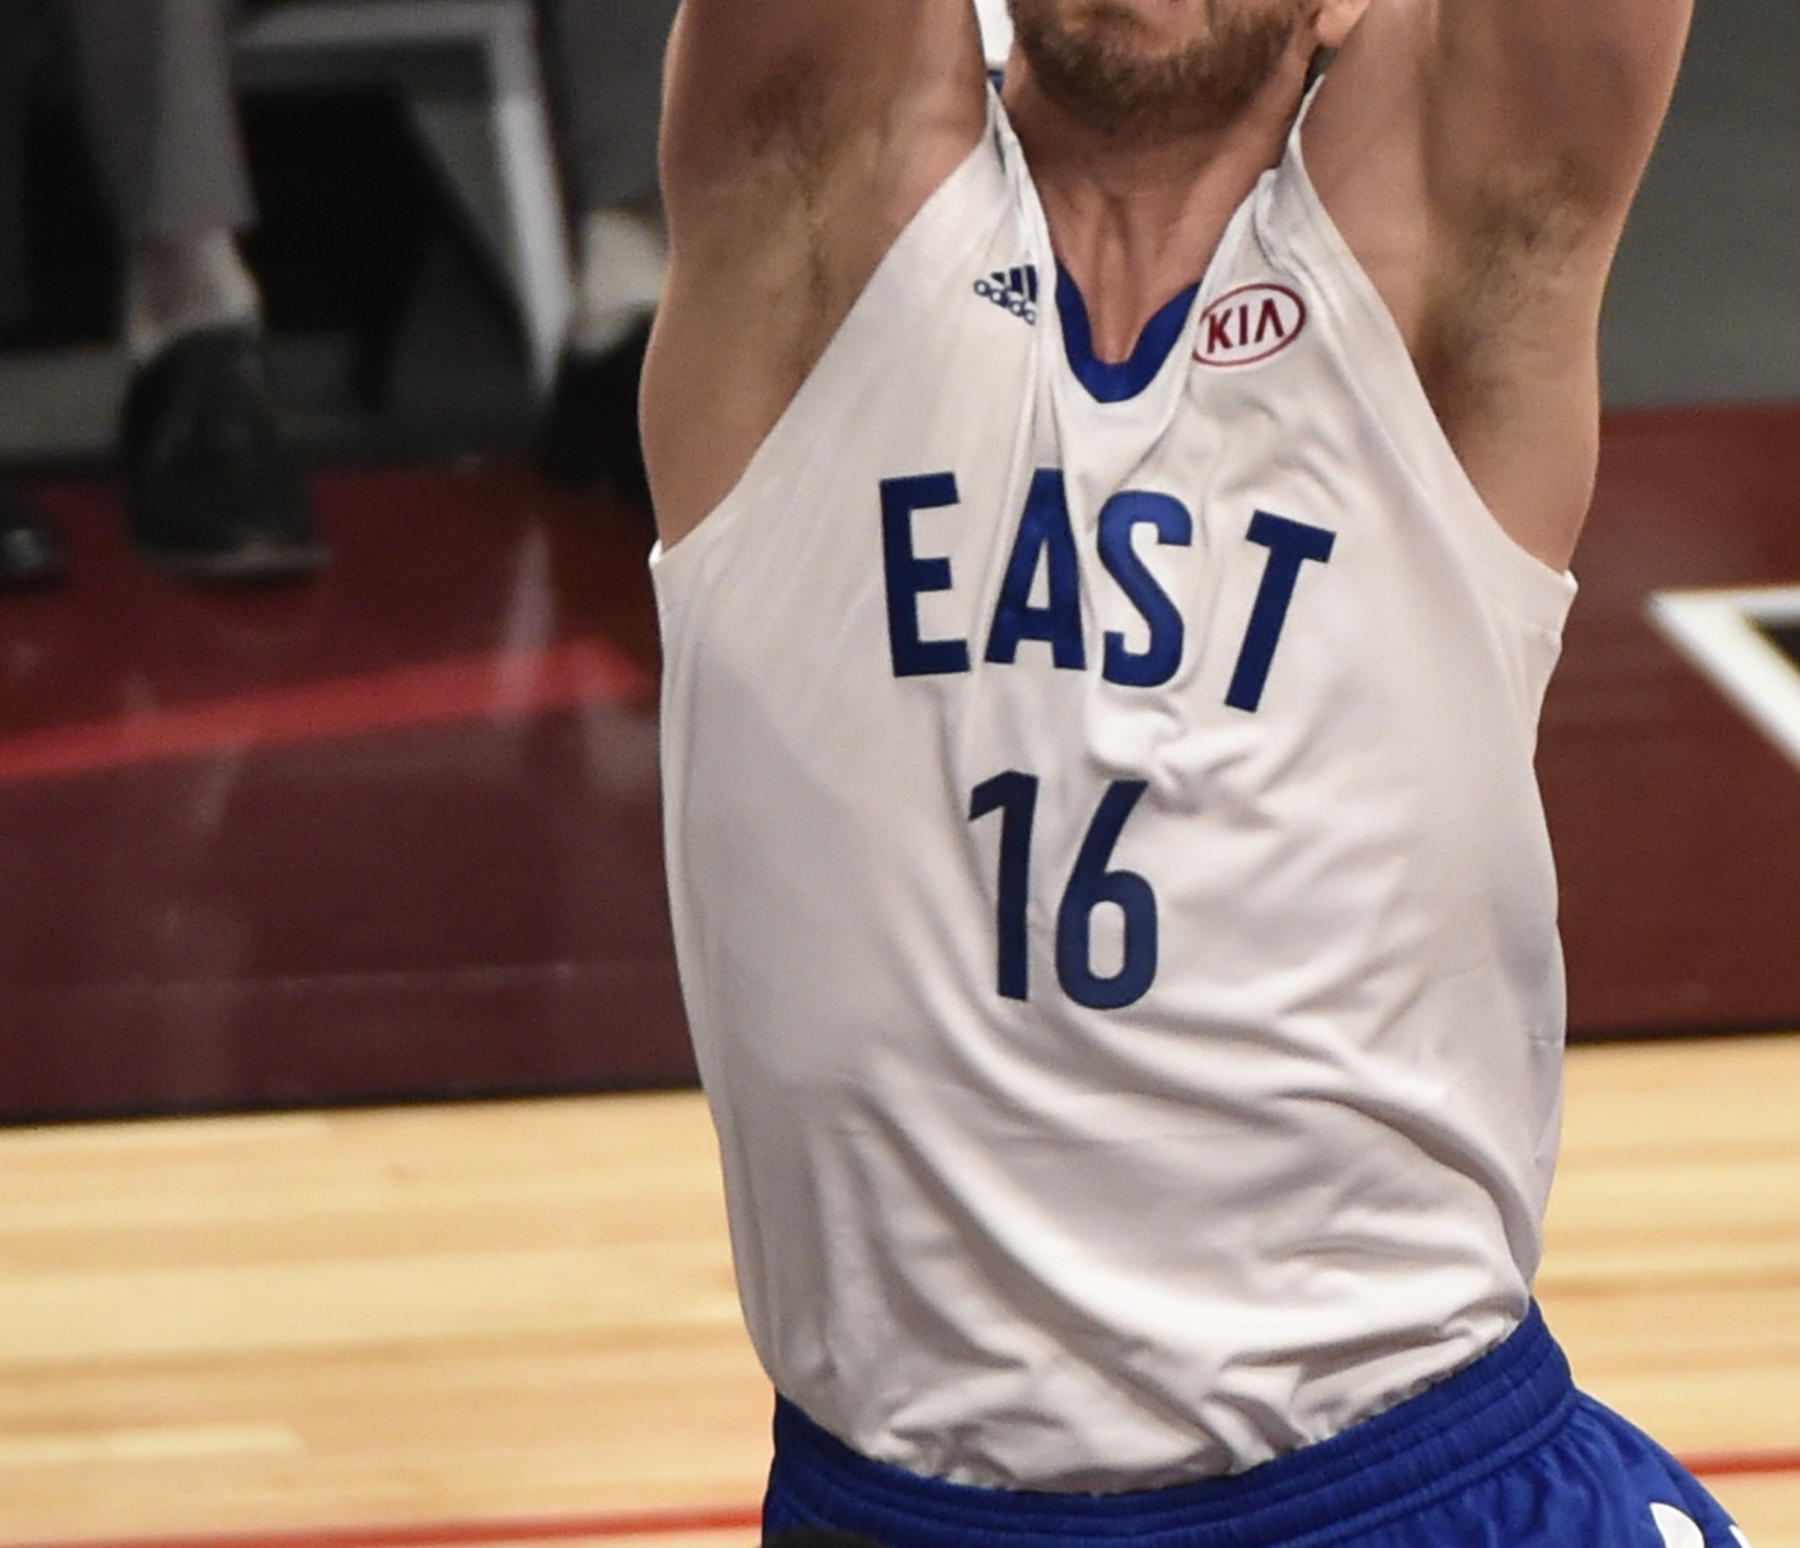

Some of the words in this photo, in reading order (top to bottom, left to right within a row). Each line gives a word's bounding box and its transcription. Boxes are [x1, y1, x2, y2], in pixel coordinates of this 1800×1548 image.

[973, 279, 1037, 326] adida
[1205, 298, 1285, 354] KIA
[879, 468, 1337, 713] EAST
[968, 769, 1158, 1010] 16
